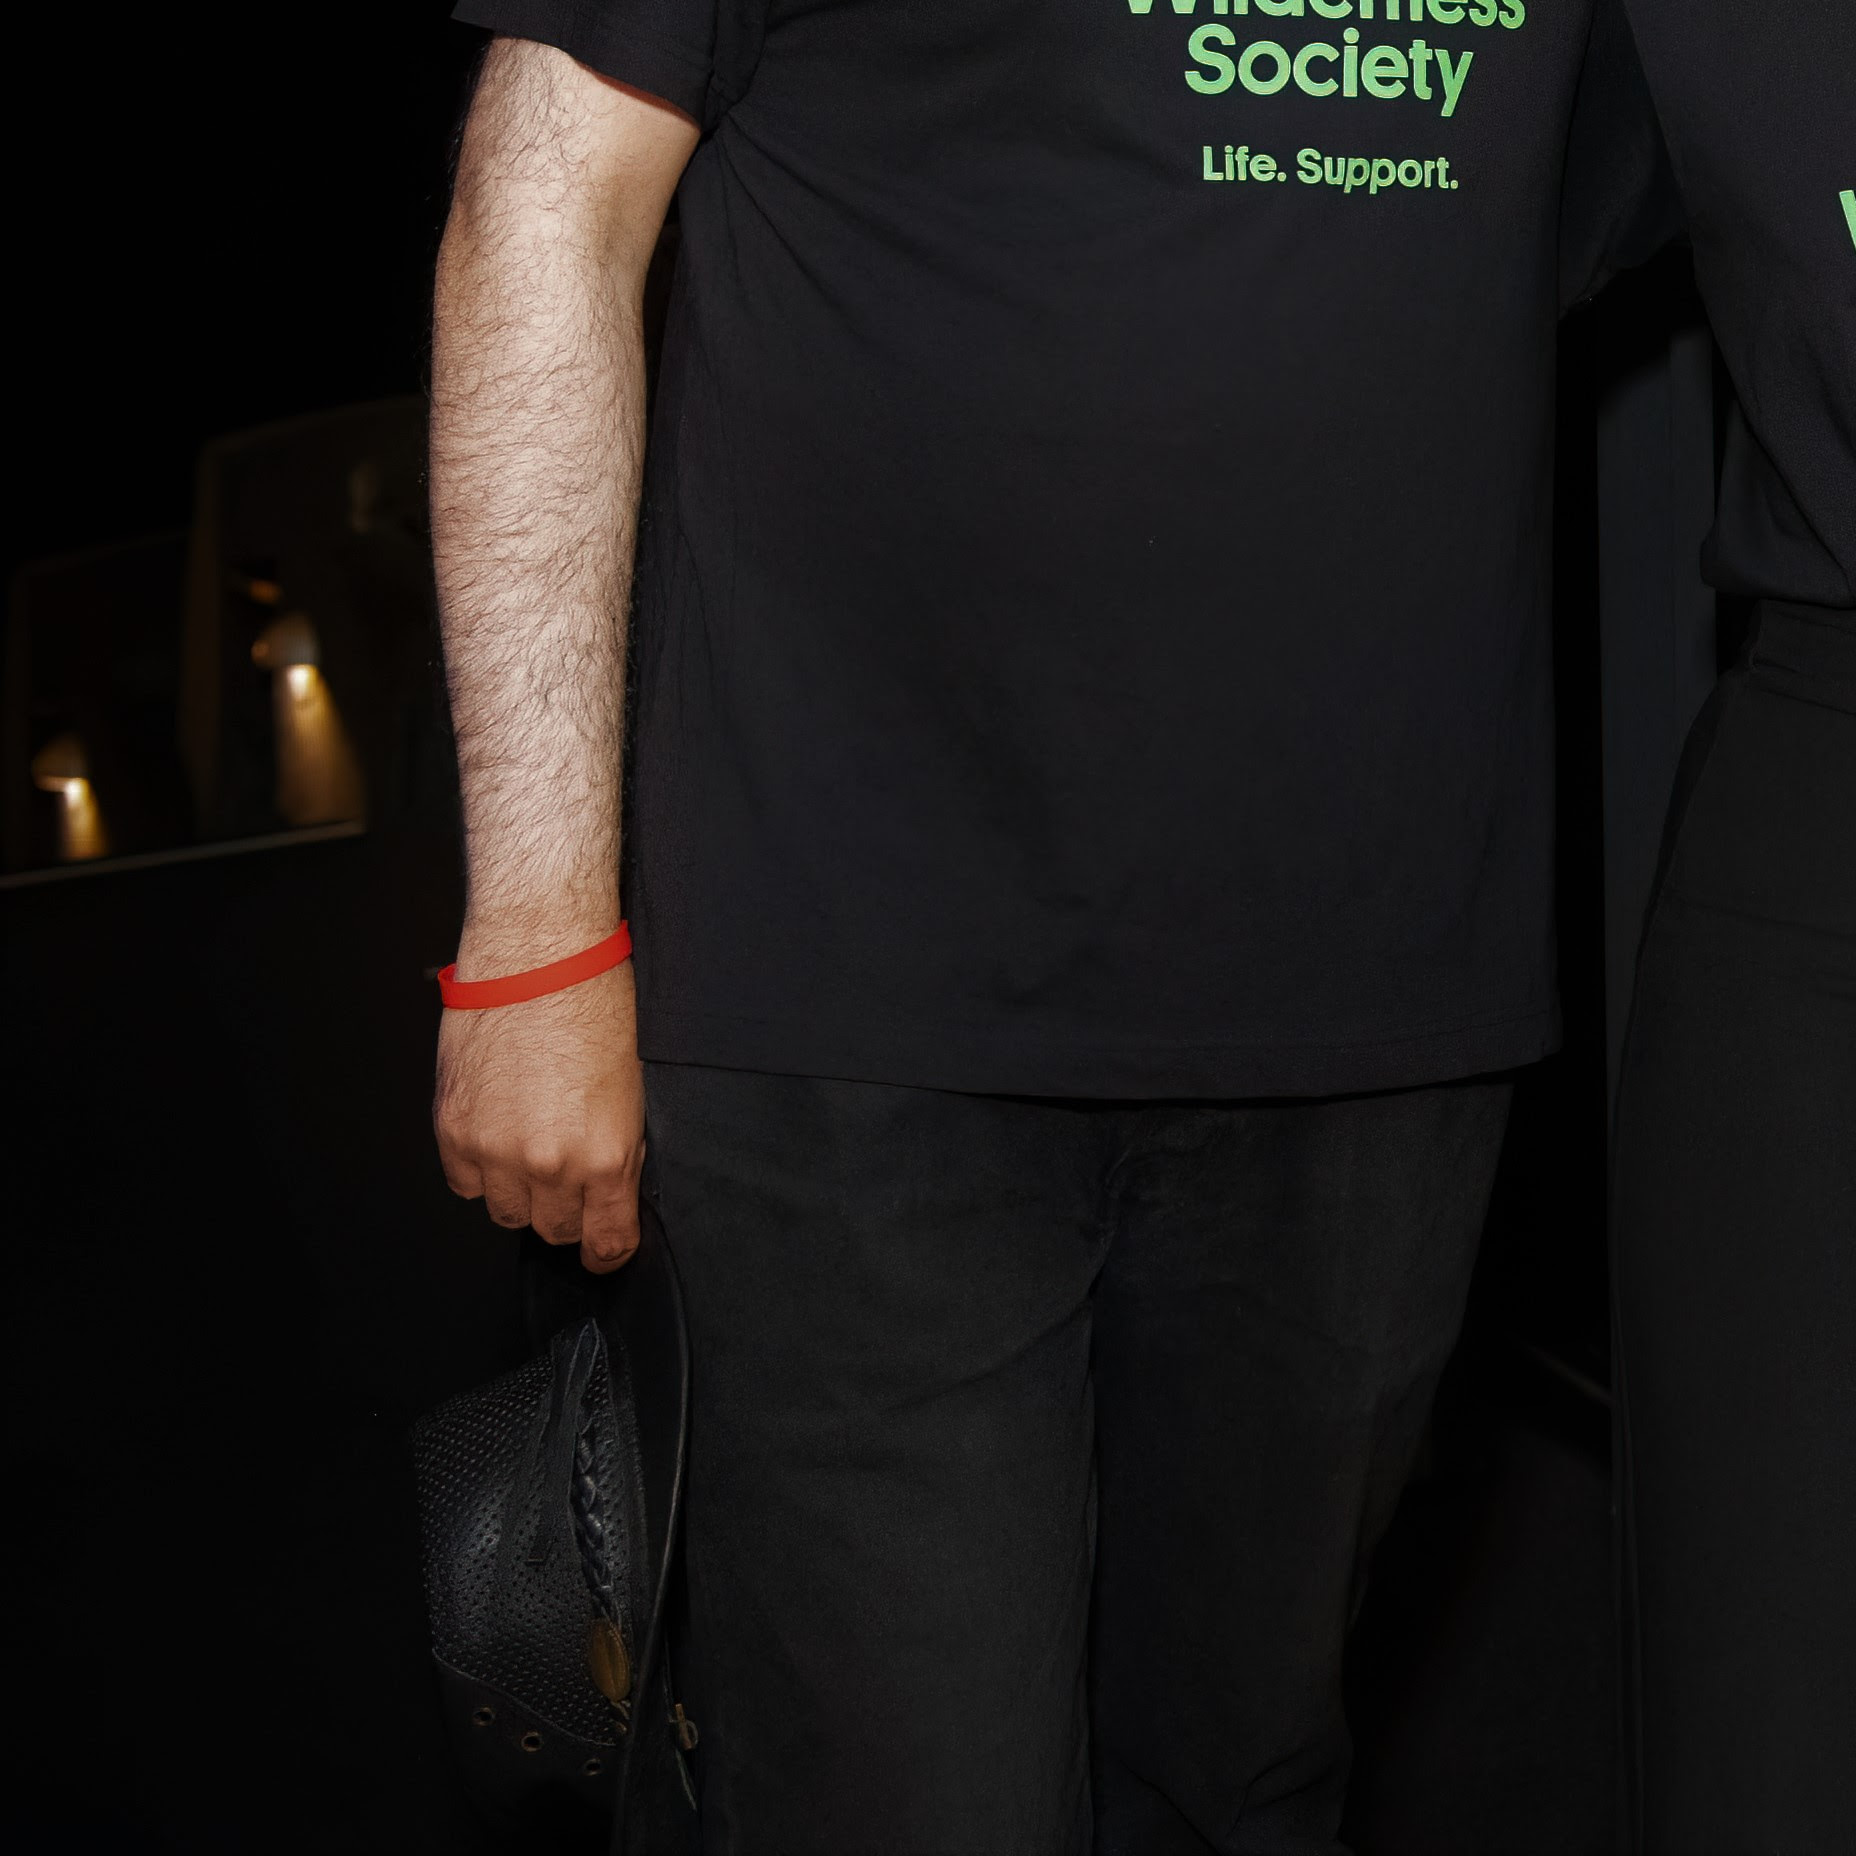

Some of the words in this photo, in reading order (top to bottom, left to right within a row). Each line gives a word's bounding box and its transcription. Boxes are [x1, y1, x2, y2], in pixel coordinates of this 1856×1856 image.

[1185, 24, 1474, 118] Society
[1203, 145, 1287, 183] Life.
[1297, 147, 1459, 195] Support.
